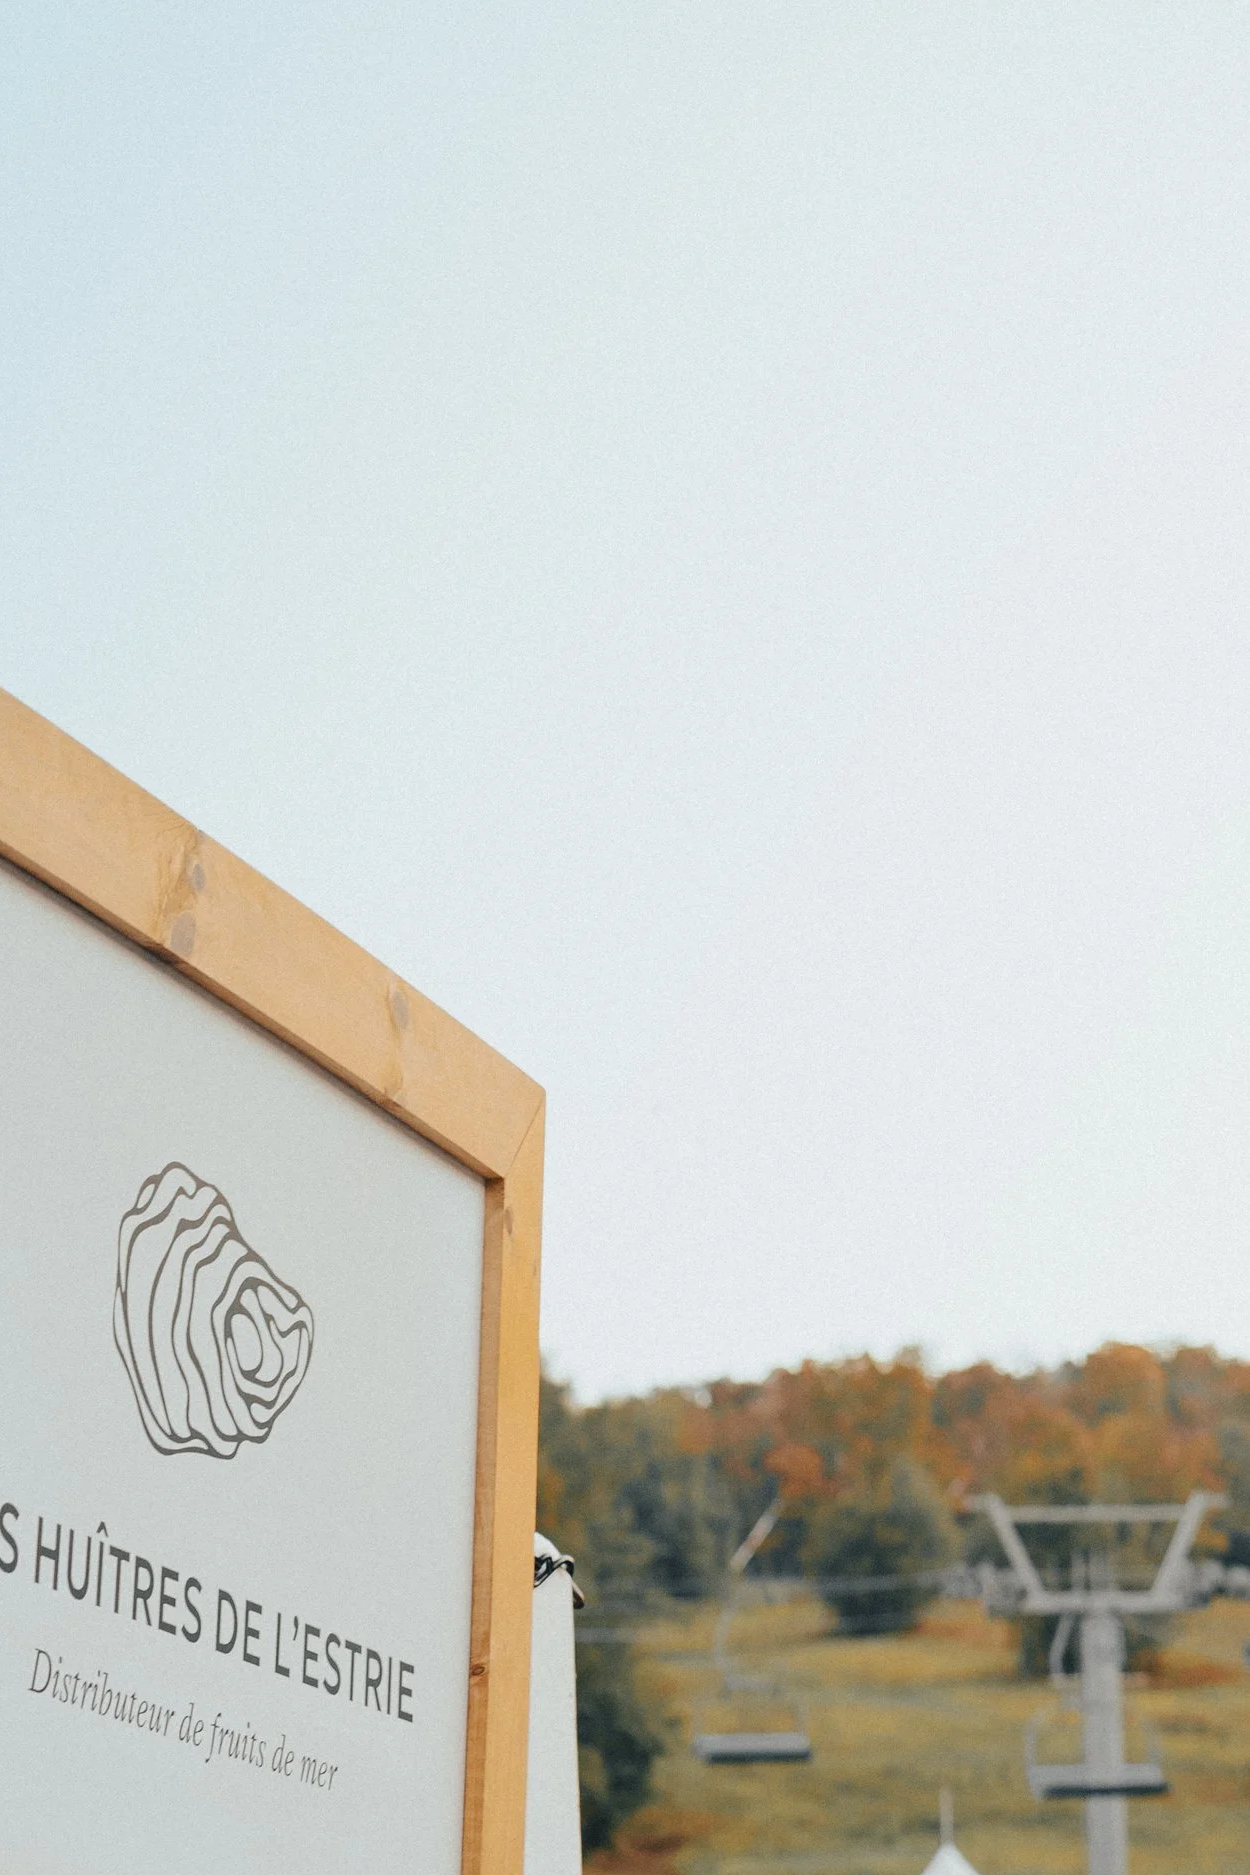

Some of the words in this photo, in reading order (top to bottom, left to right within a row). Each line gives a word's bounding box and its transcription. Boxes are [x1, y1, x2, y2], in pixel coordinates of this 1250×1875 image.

[34, 1516, 202, 1643] HUÎTRES
[215, 1588, 263, 1667] DE
[274, 1612, 416, 1723] L'ESTRIE
[28, 1648, 176, 1738] Distributeur
[178, 1703, 205, 1748] de
[205, 1712, 266, 1768] fruits
[271, 1734, 295, 1777] de
[300, 1755, 338, 1791] mer
